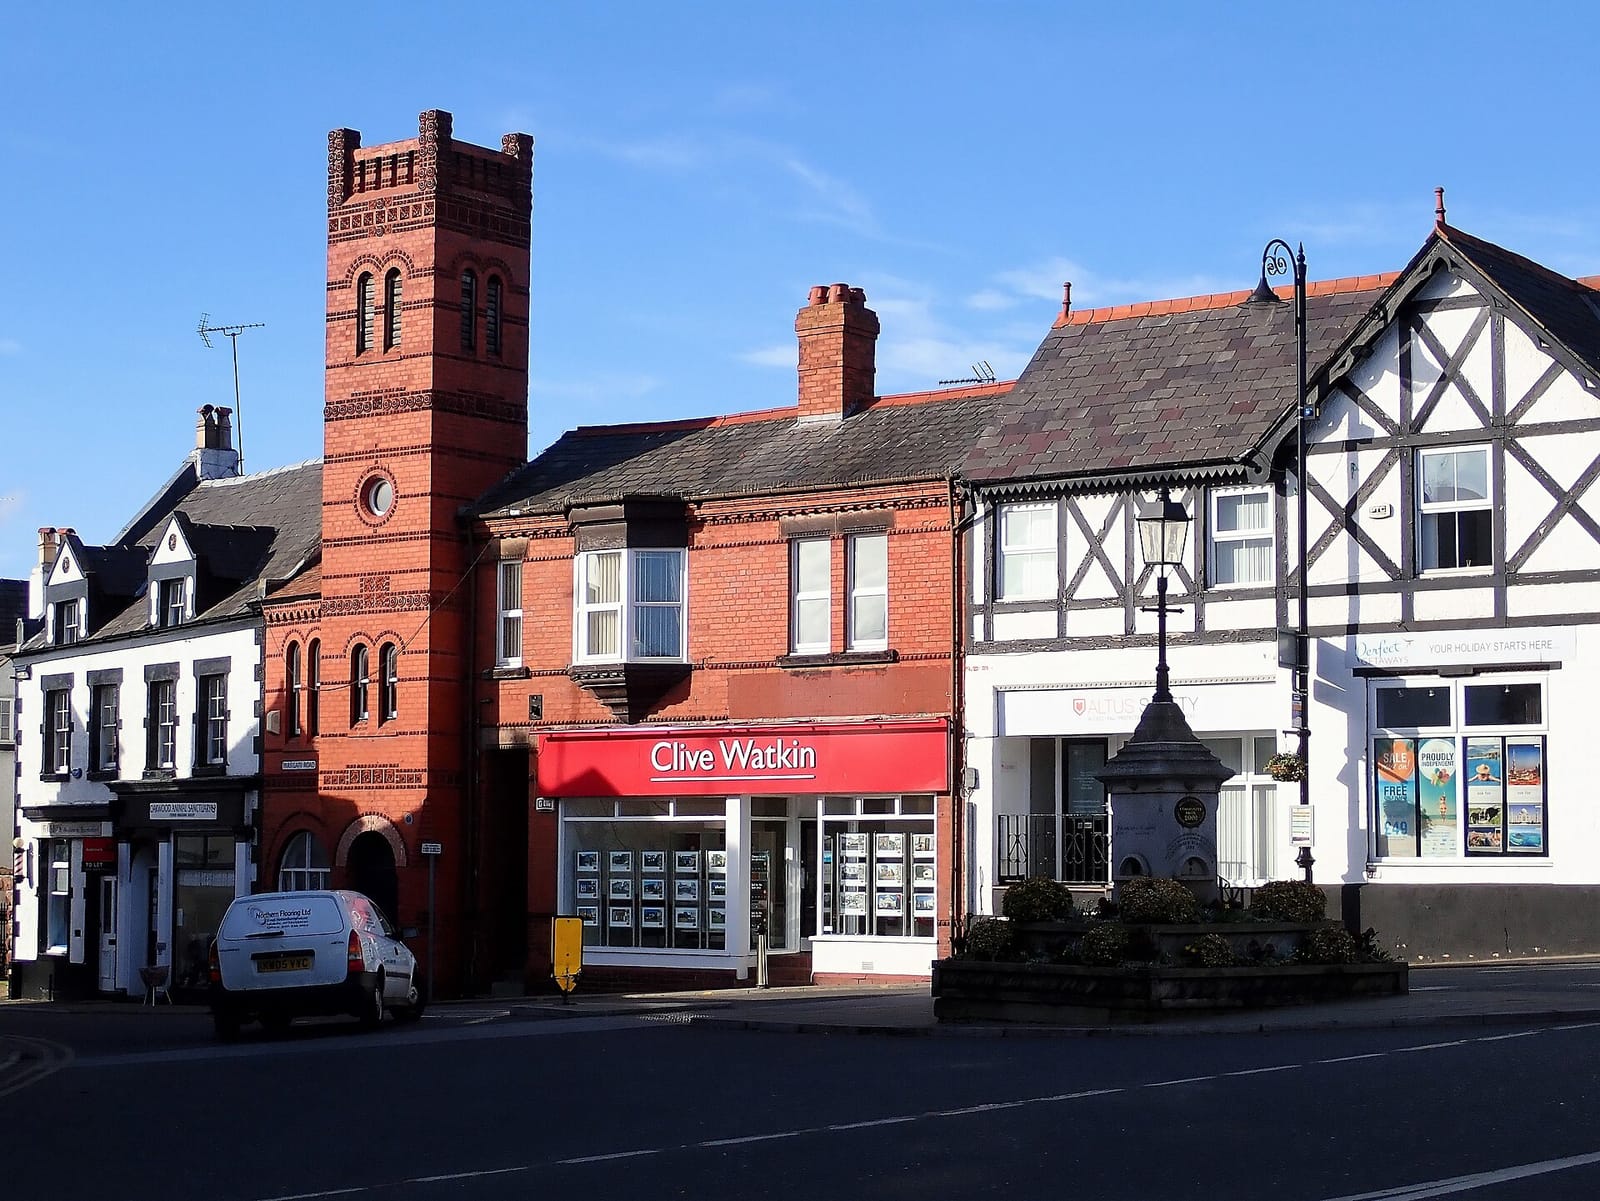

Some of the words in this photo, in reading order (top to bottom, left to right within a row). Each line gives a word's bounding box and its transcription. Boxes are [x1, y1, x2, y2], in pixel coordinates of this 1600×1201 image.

[1429, 643, 1453, 653] YOUR
[1455, 642, 1491, 653] HOLIDAY
[1493, 640, 1527, 652] STARTS
[1088, 698, 1132, 714] ALTUS
[651, 741, 715, 771] Clive
[718, 738, 817, 770] Watkin
[1383, 752, 1407, 763] SALE
[1421, 753, 1454, 761] PROUDLY
[1384, 785, 1407, 796] FREE
[1385, 821, 1407, 835] £49
[280, 909, 300, 917] Flooring
[301, 908, 311, 916] Ltd
